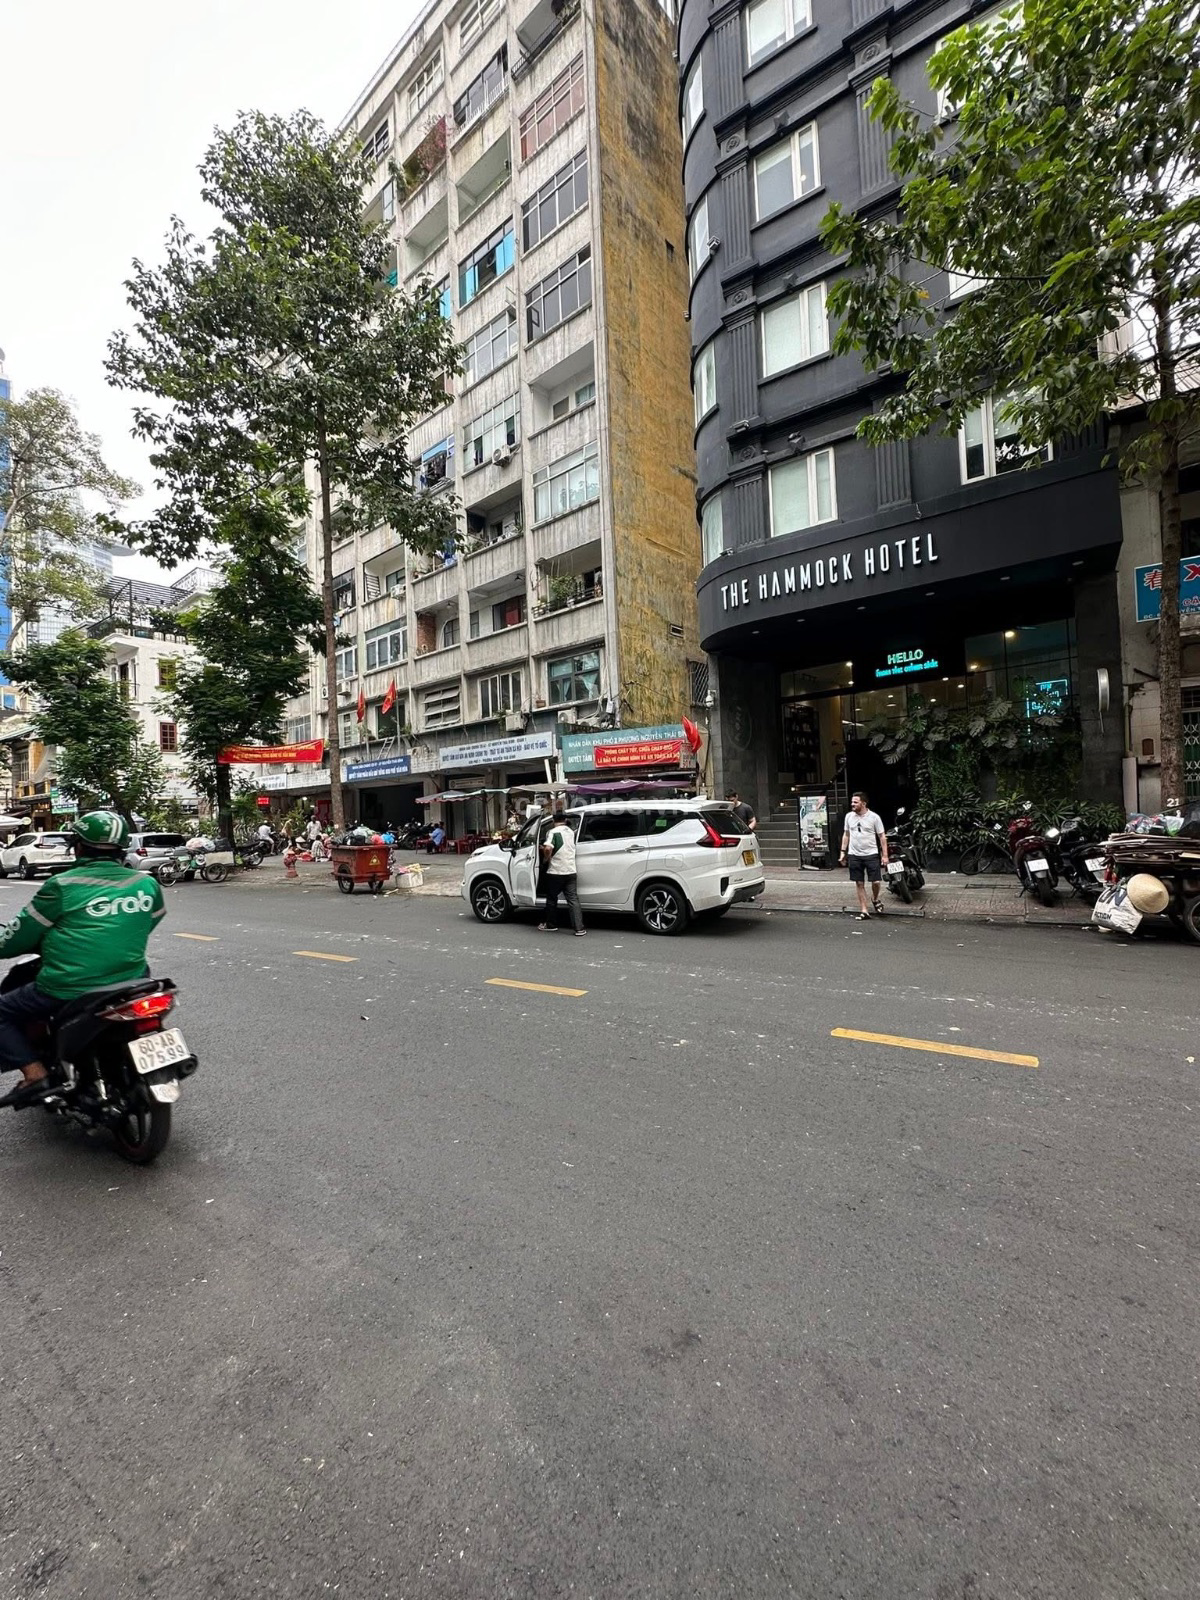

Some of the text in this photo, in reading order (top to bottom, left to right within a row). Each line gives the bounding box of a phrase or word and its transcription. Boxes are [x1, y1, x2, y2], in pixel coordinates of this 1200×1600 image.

[721, 533, 938, 610] THE HAMMOCK HOTEL
[887, 649, 924, 665] HELLO
[892, 665, 903, 674] the
[904, 663, 923, 672] other
[924, 659, 938, 669] side
[1166, 798, 1181, 807] 21
[85, 889, 154, 917] Grab
[138, 1032, 176, 1055] 60-AB
